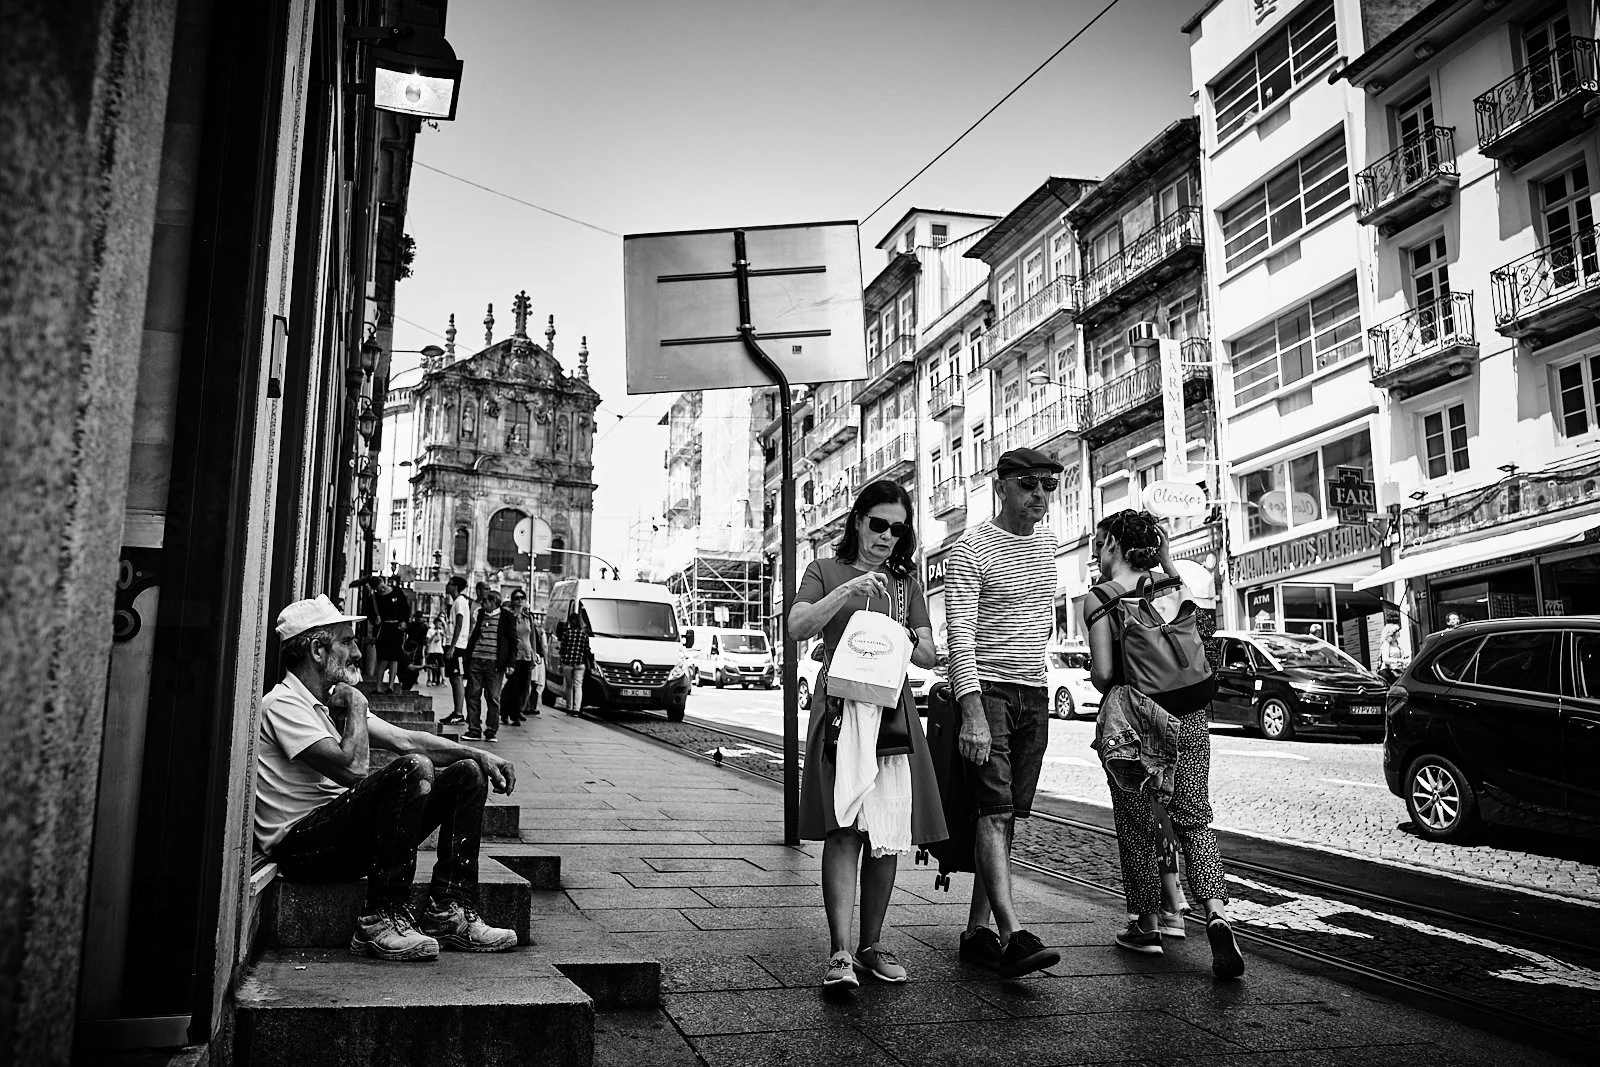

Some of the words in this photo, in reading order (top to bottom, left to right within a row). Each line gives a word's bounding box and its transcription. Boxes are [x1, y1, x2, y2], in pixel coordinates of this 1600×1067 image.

[1336, 487, 1373, 506] FAR
[1290, 537, 1317, 566] DOS
[1253, 593, 1270, 606] ATM
